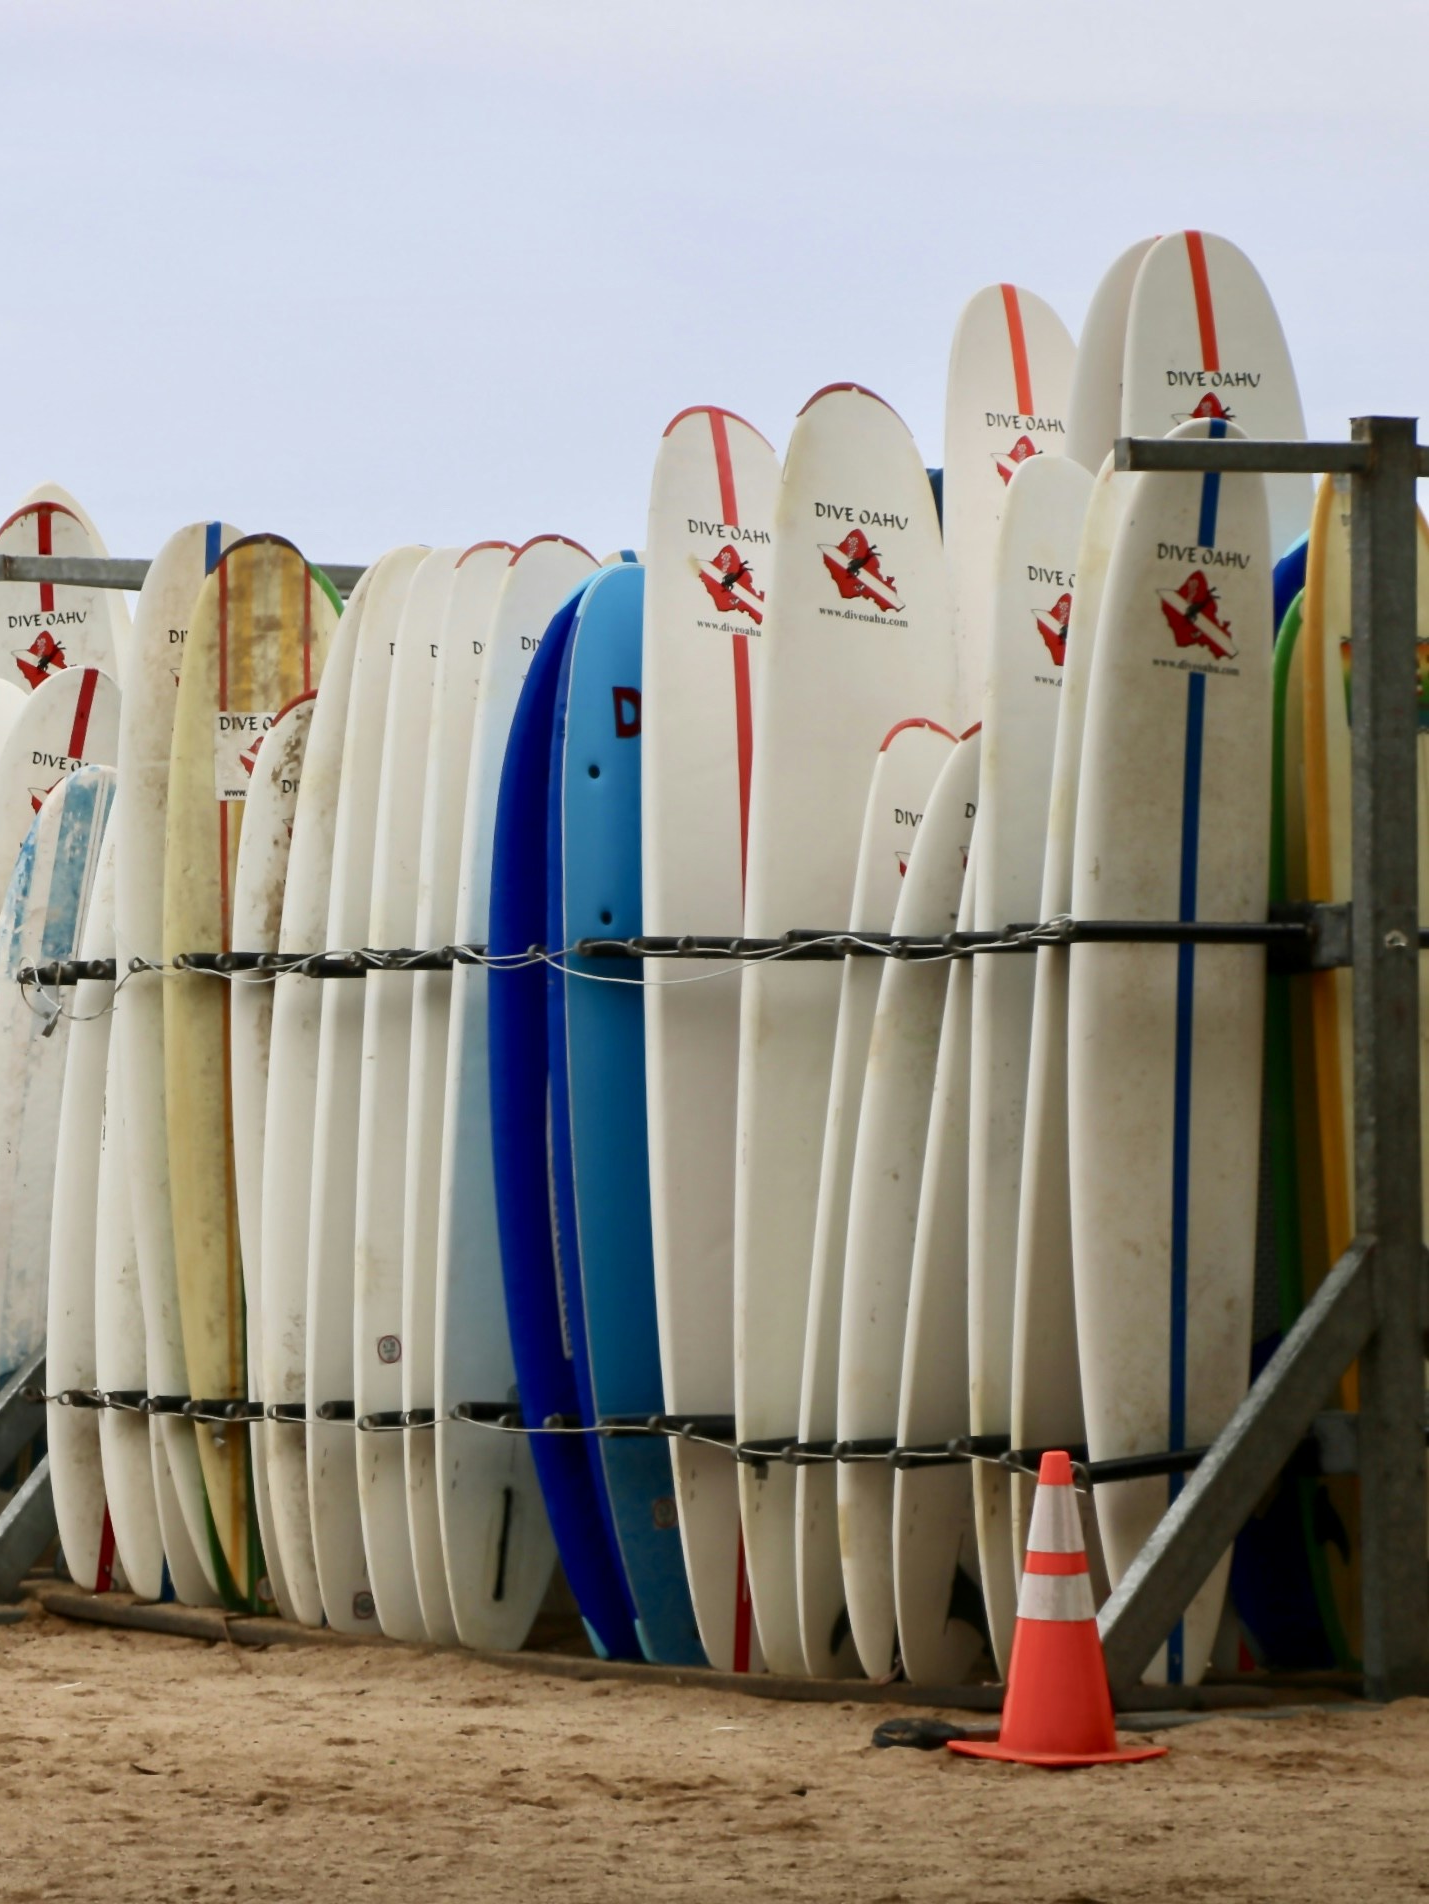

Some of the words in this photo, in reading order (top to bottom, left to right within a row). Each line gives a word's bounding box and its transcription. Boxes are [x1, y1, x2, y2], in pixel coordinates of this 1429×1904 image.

[1166, 370, 1206, 387] DIVE
[1211, 371, 1261, 388] OAHU
[985, 412, 1022, 430] DIVE
[814, 502, 854, 522] DIVE
[859, 510, 909, 531] OAHU
[687, 519, 726, 538] DIVE
[1157, 542, 1197, 563] DIVE
[1202, 549, 1250, 570] OAHU
[1027, 565, 1065, 586] DIVE
[7, 613, 42, 628] DIVE
[46, 611, 87, 626] OAHU
[818, 607, 909, 628] www.diveoahu.com
[168, 629, 188, 643] DI
[218, 716, 258, 731] DIVE
[32, 751, 67, 771] DIVE
[281, 779, 300, 794] DI
